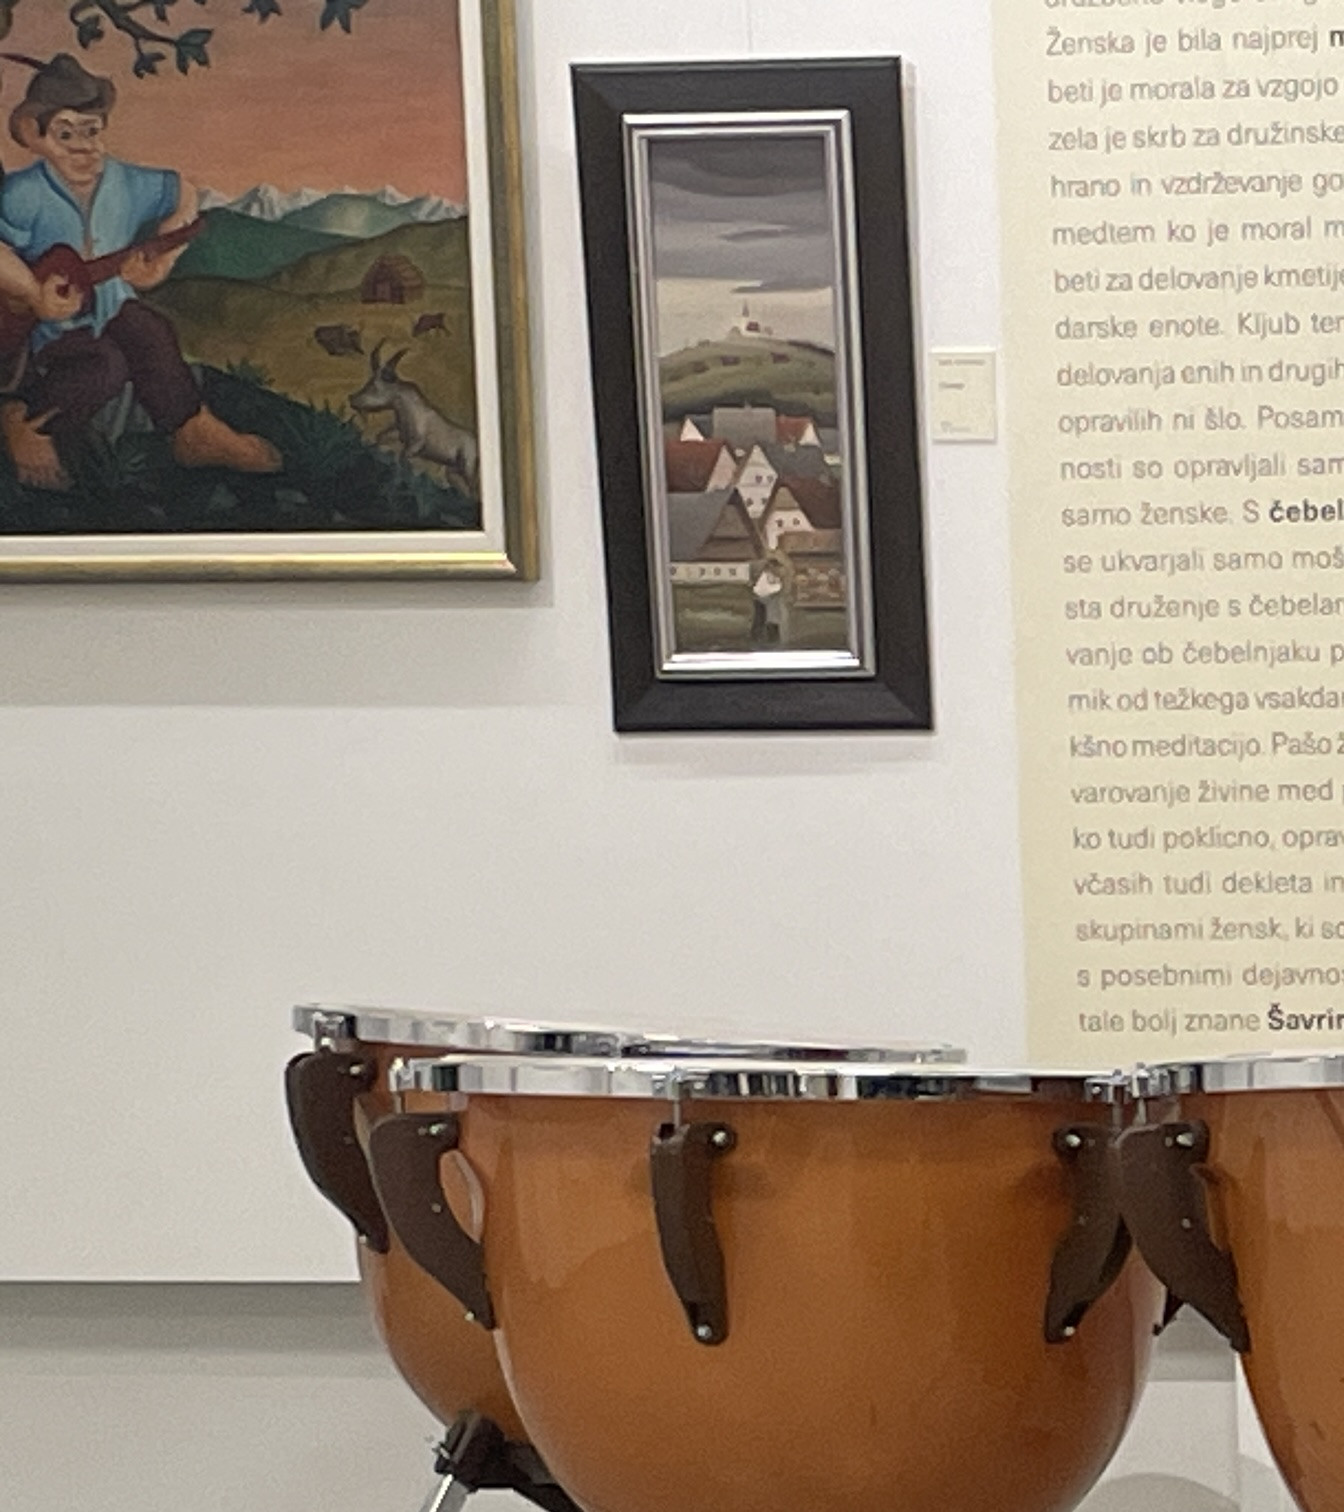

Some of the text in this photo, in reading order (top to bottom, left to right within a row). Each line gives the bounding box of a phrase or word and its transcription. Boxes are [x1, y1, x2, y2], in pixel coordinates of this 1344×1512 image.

[1045, 25, 1136, 57] Ženska
[1144, 29, 1168, 58] je
[1177, 27, 1222, 53] bila
[1231, 25, 1319, 56] najprej
[1047, 78, 1094, 104] beti
[1099, 79, 1123, 109] je
[1129, 75, 1216, 101] morala
[1221, 78, 1251, 100] za
[1255, 76, 1340, 103] vzgojo
[1048, 126, 1099, 151] zela
[1104, 126, 1127, 155] je
[1132, 123, 1187, 150] skrb
[1191, 127, 1221, 148] za
[1050, 174, 1122, 199] hrano
[1130, 172, 1153, 196] in
[1160, 170, 1303, 199] vzdrževanje
[1052, 220, 1156, 246] medtem
[1166, 219, 1197, 243] ko
[1206, 218, 1230, 248] je
[1240, 215, 1312, 241] moral
[1053, 268, 1101, 294] beti
[1104, 272, 1134, 292] za
[1137, 265, 1259, 295] delovanje
[1054, 314, 1139, 340] darske
[1148, 314, 1225, 339] enote.
[1237, 311, 1301, 341] Kljub
[1056, 361, 1176, 391] delovanja
[1180, 360, 1235, 385] enih
[1240, 360, 1264, 383] in
[1057, 408, 1163, 438] opravilih
[1172, 408, 1195, 431] ni
[1204, 406, 1246, 431] šlo.
[1060, 457, 1123, 481] nosti
[1132, 459, 1164, 480] so
[1173, 452, 1287, 483] opravljali
[1061, 506, 1132, 528] samo
[1139, 501, 1233, 526] ženske.
[1242, 498, 1261, 525] S
[1063, 554, 1093, 574] se
[1100, 548, 1205, 577] ukvarjali
[1212, 550, 1284, 572] samo
[1064, 598, 1103, 621] sta
[1109, 594, 1221, 623] druženje
[1227, 598, 1242, 618] s
[1065, 645, 1134, 671] vanje
[1141, 641, 1174, 666] ob
[1181, 639, 1321, 669] čebelnjaku
[1067, 688, 1113, 711] mik
[1116, 687, 1149, 712] od
[1153, 687, 1250, 716] težkega
[1069, 734, 1128, 759] kšno
[1131, 733, 1265, 763] meditacijo.
[1270, 730, 1333, 756] Pašo
[1070, 782, 1191, 809] varovanje
[1197, 779, 1271, 804] živine
[1277, 777, 1334, 802] med
[1072, 826, 1103, 851] ko
[1107, 826, 1156, 851] tudi
[1162, 824, 1276, 854] poklicno,
[1073, 872, 1154, 896] včasih
[1162, 870, 1212, 896] tudi
[1221, 870, 1313, 895] dekleta
[1075, 919, 1204, 946] skupinami
[1208, 916, 1290, 942] žensk,
[1294, 916, 1315, 940] ki
[1076, 968, 1091, 988] s
[1100, 963, 1233, 991] posebnimi
[1078, 1010, 1125, 1033] tale
[1130, 1008, 1178, 1037] bolj
[1183, 1012, 1261, 1033] znane
